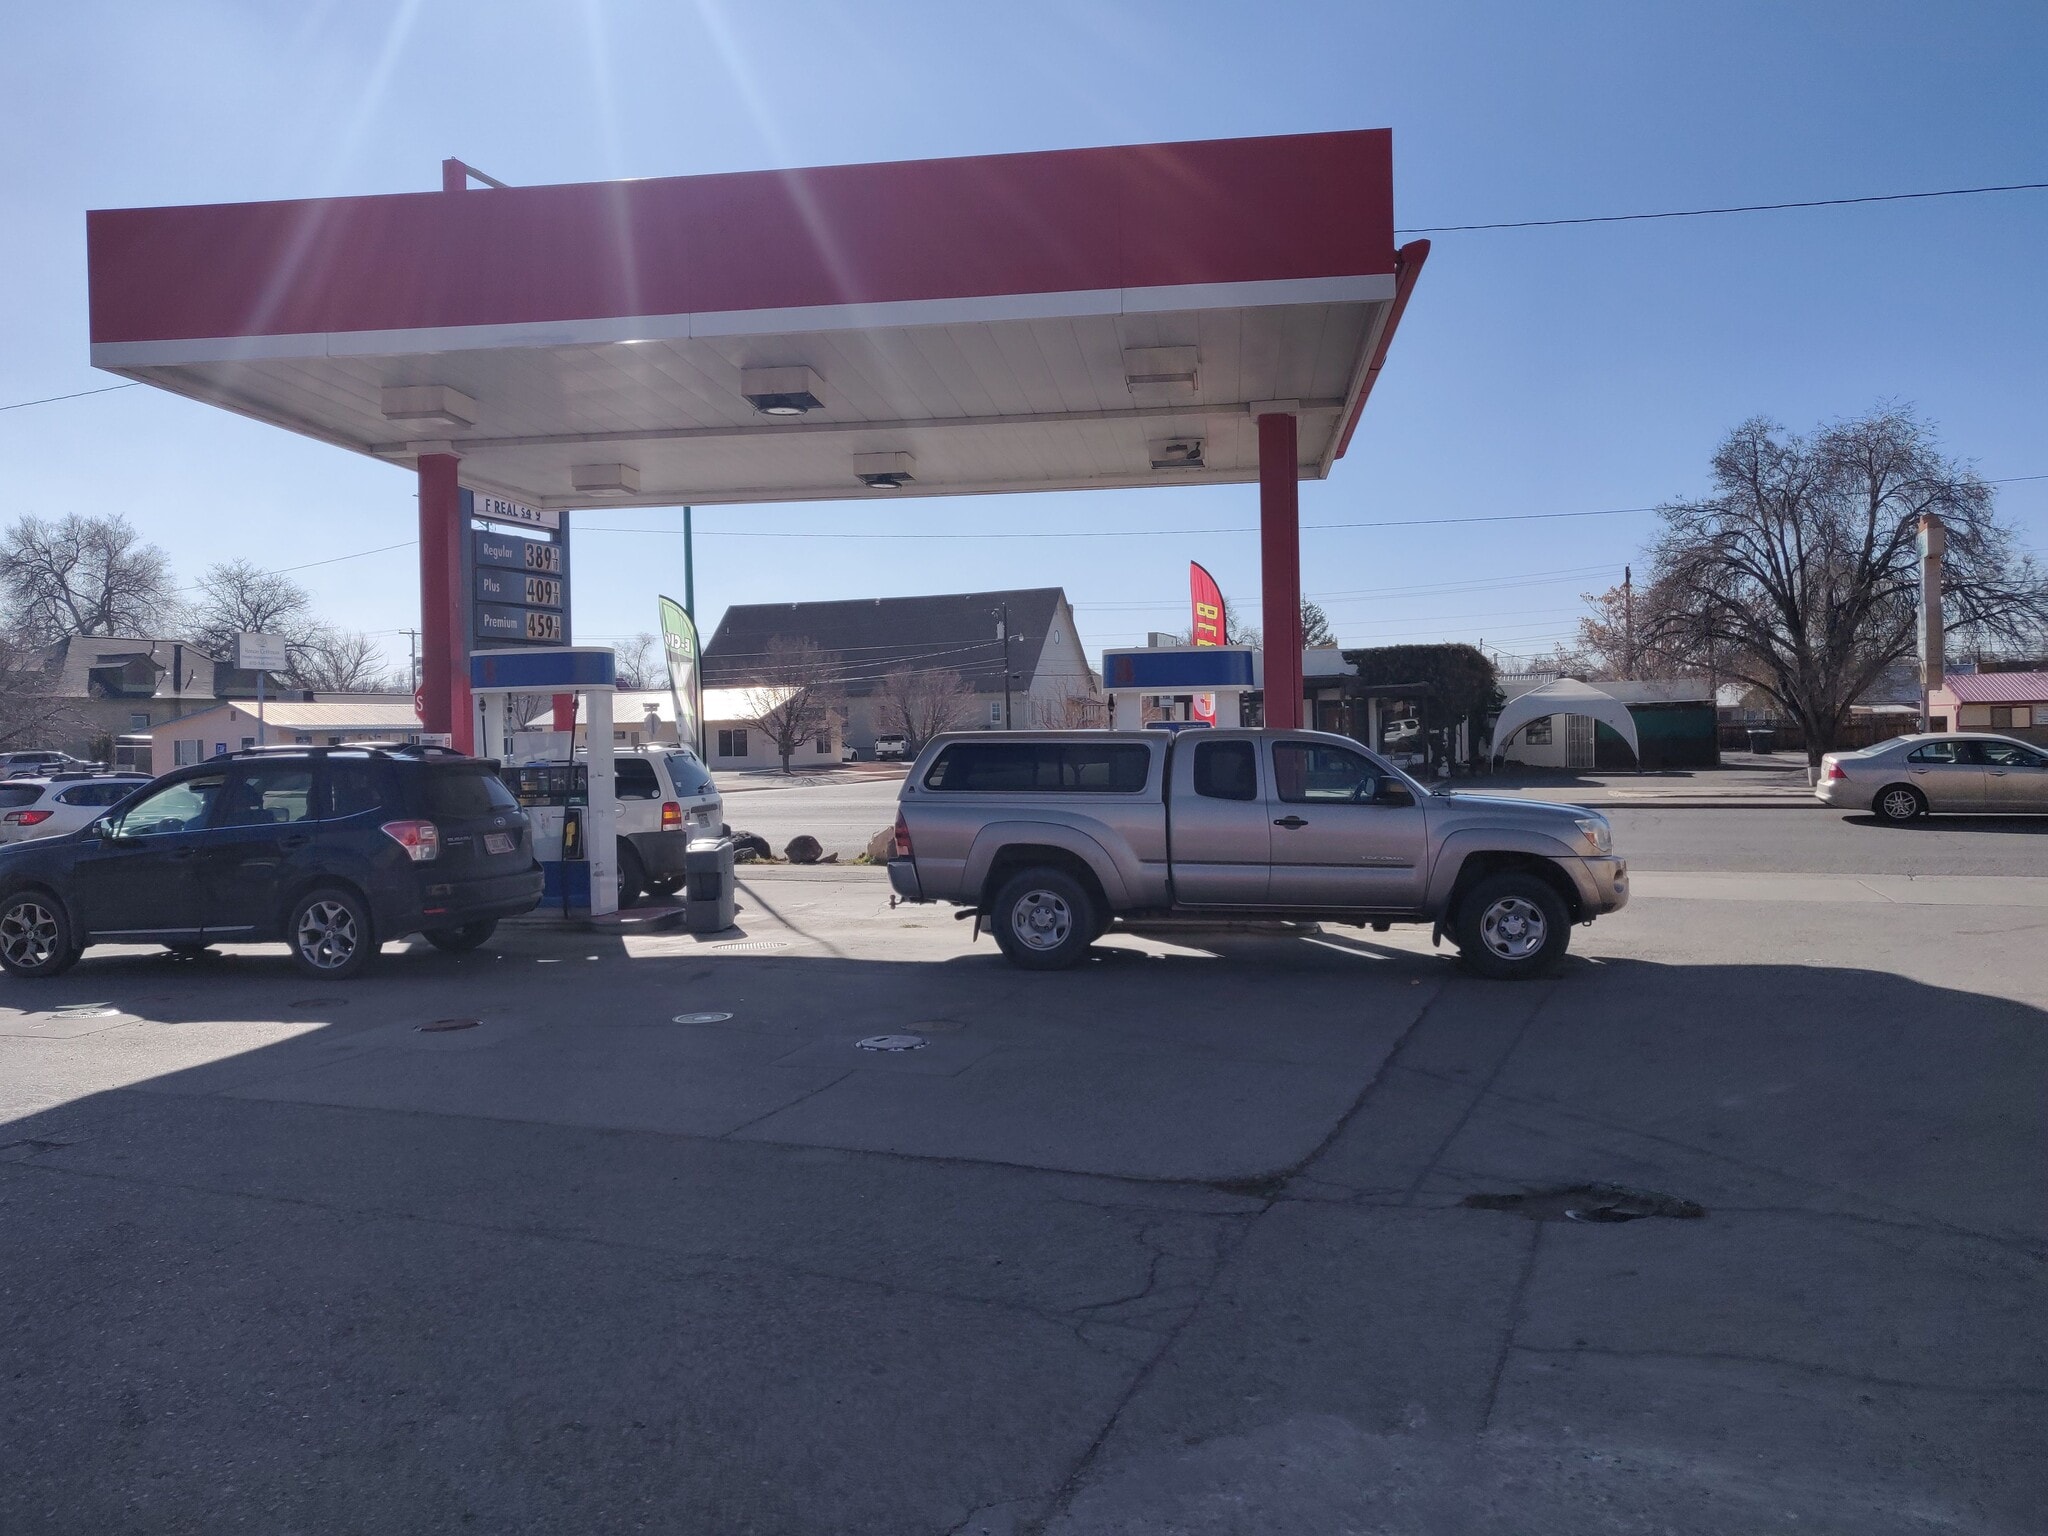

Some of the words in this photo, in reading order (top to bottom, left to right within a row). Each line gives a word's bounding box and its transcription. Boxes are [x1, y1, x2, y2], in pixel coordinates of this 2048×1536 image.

[494, 500, 518, 517] REAL
[483, 543, 513, 559] Regular
[526, 544, 552, 570] 389
[483, 578, 500, 592] Plus
[527, 579, 552, 604] 409
[484, 614, 518, 629] Premium
[528, 613, 553, 638] 459
